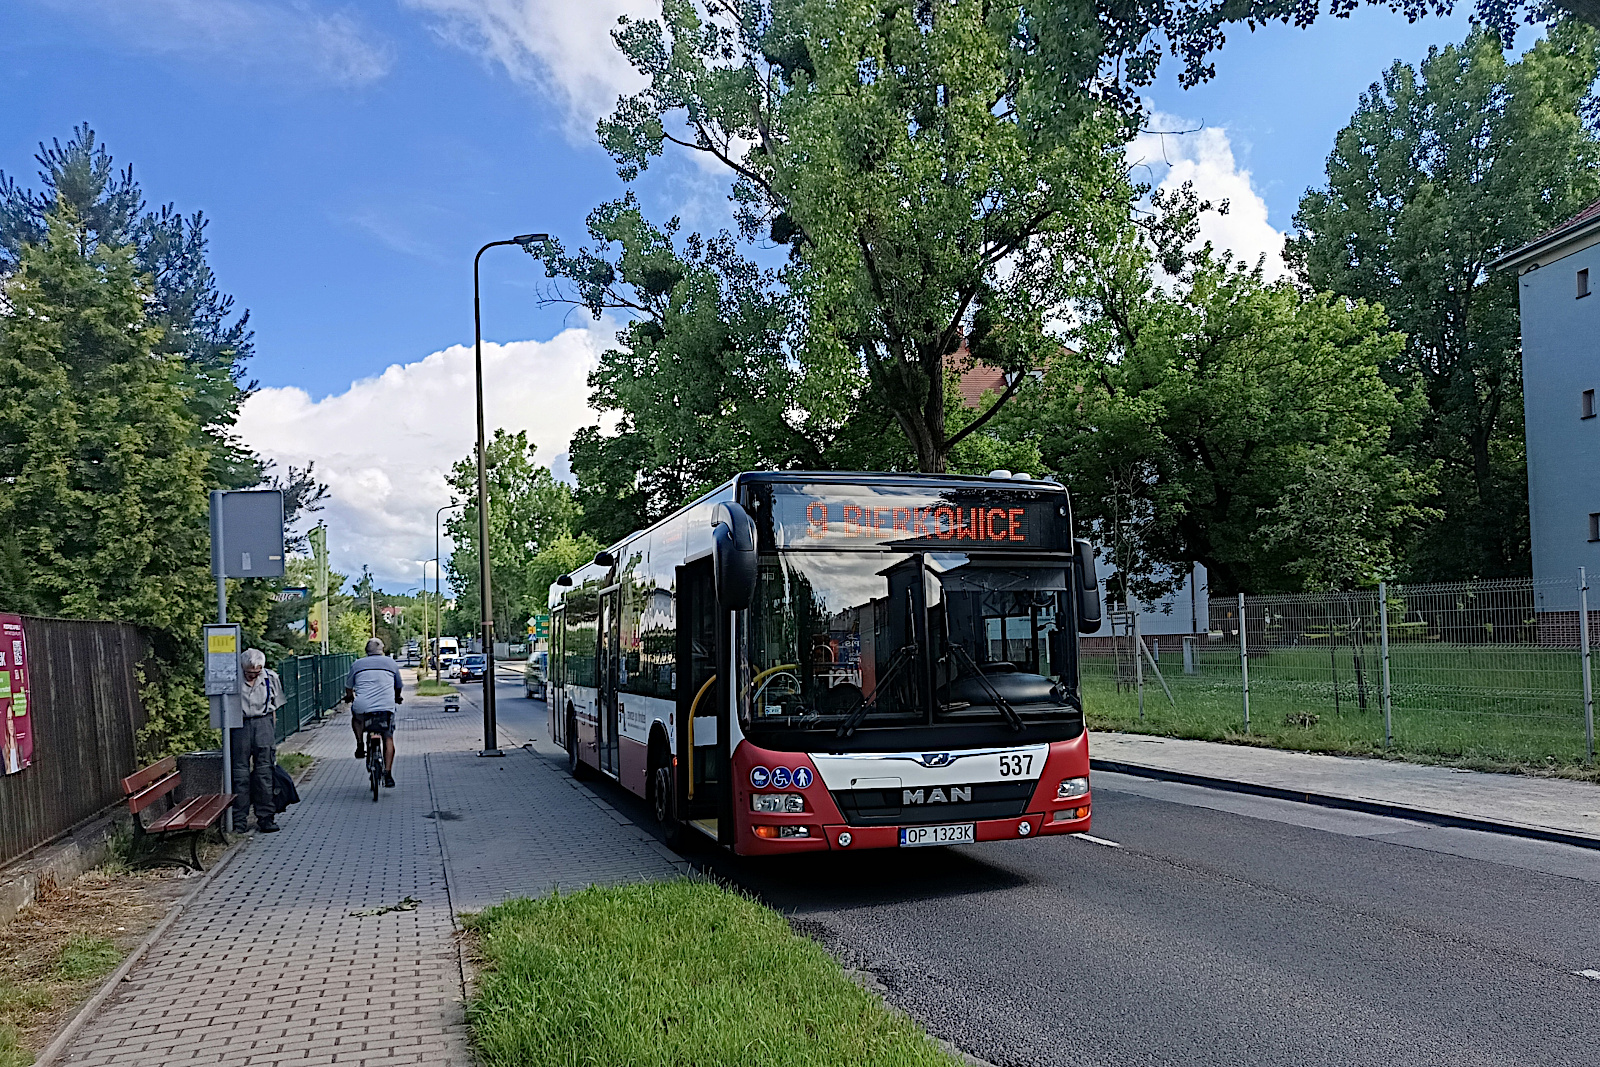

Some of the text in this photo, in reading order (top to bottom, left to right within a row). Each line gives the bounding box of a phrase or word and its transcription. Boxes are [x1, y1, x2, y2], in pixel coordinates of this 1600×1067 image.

[805, 500, 1026, 541] 9 BIERKOWICE
[999, 754, 1034, 777] 537
[902, 786, 972, 805] MAN
[908, 825, 972, 843] OP 1323K
